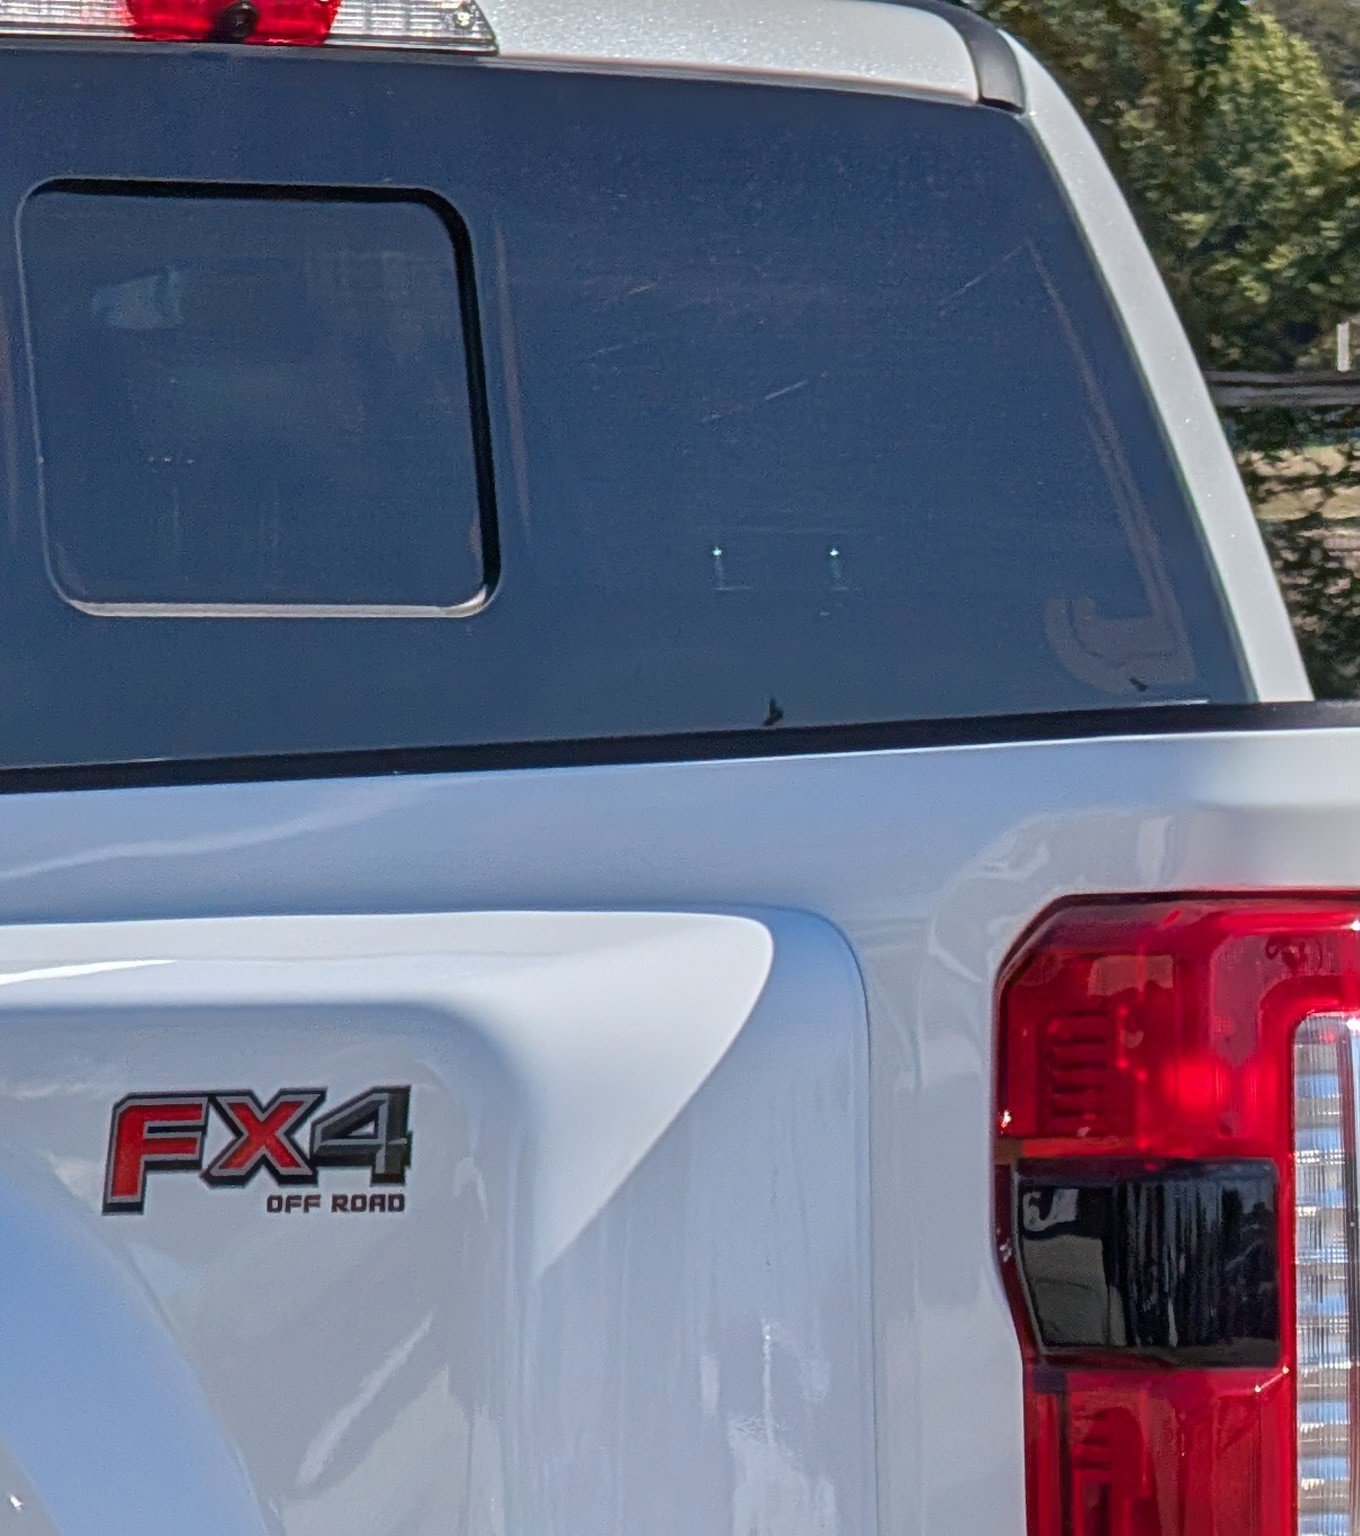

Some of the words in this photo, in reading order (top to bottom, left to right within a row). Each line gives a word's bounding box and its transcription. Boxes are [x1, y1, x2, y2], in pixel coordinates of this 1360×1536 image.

[102, 1085, 411, 1216] FX4
[266, 1194, 321, 1213] OFF
[331, 1193, 406, 1213] ROAD
